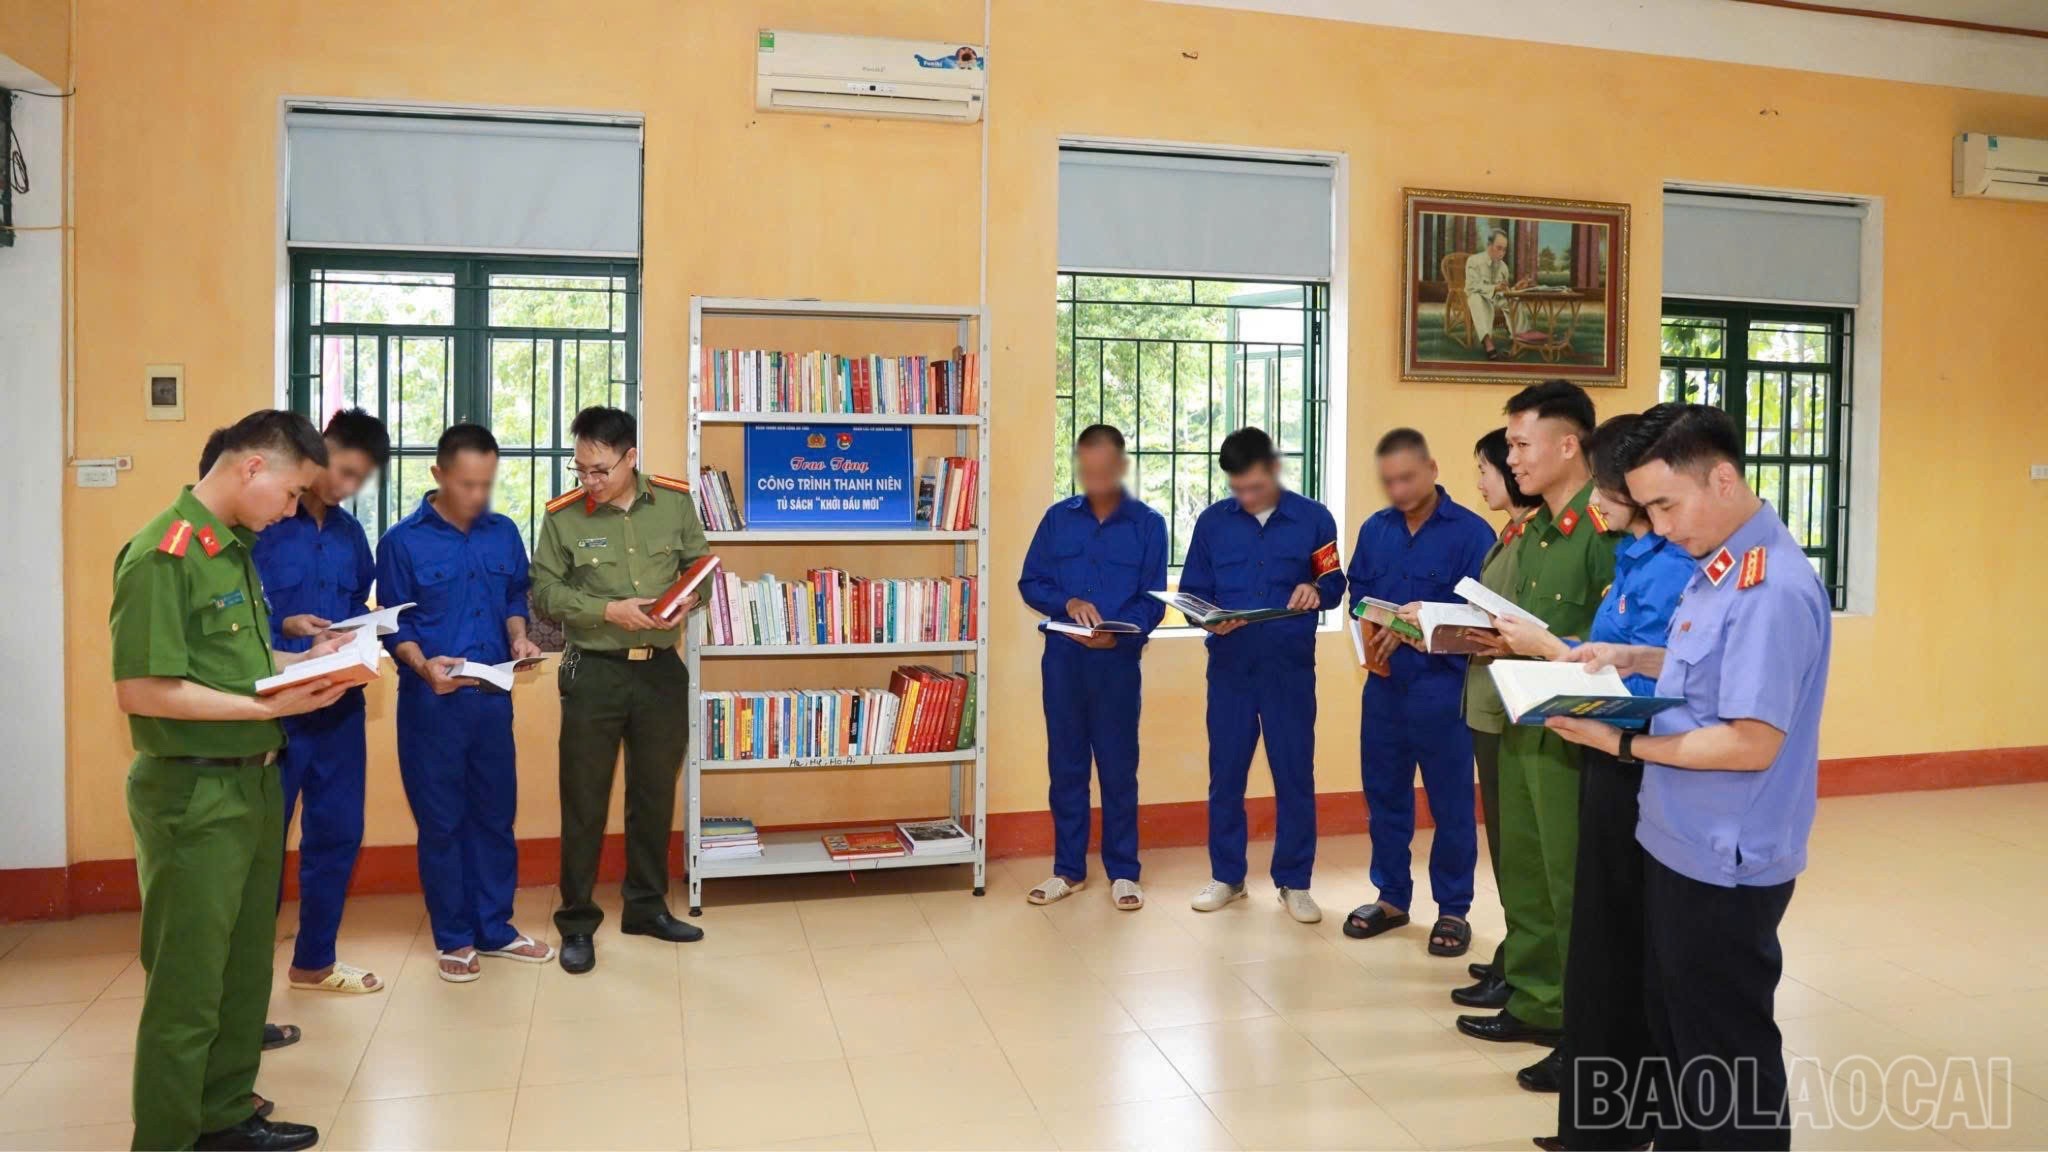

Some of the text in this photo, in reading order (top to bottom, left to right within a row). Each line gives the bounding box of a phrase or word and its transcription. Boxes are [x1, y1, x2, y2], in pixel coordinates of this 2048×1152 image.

[790, 456, 869, 473] Trao Tặng
[757, 475, 902, 491] CÔNG TRÌNH THANH NIÊN
[777, 495, 787, 510] TỦ
[790, 496, 813, 510] SÁCH
